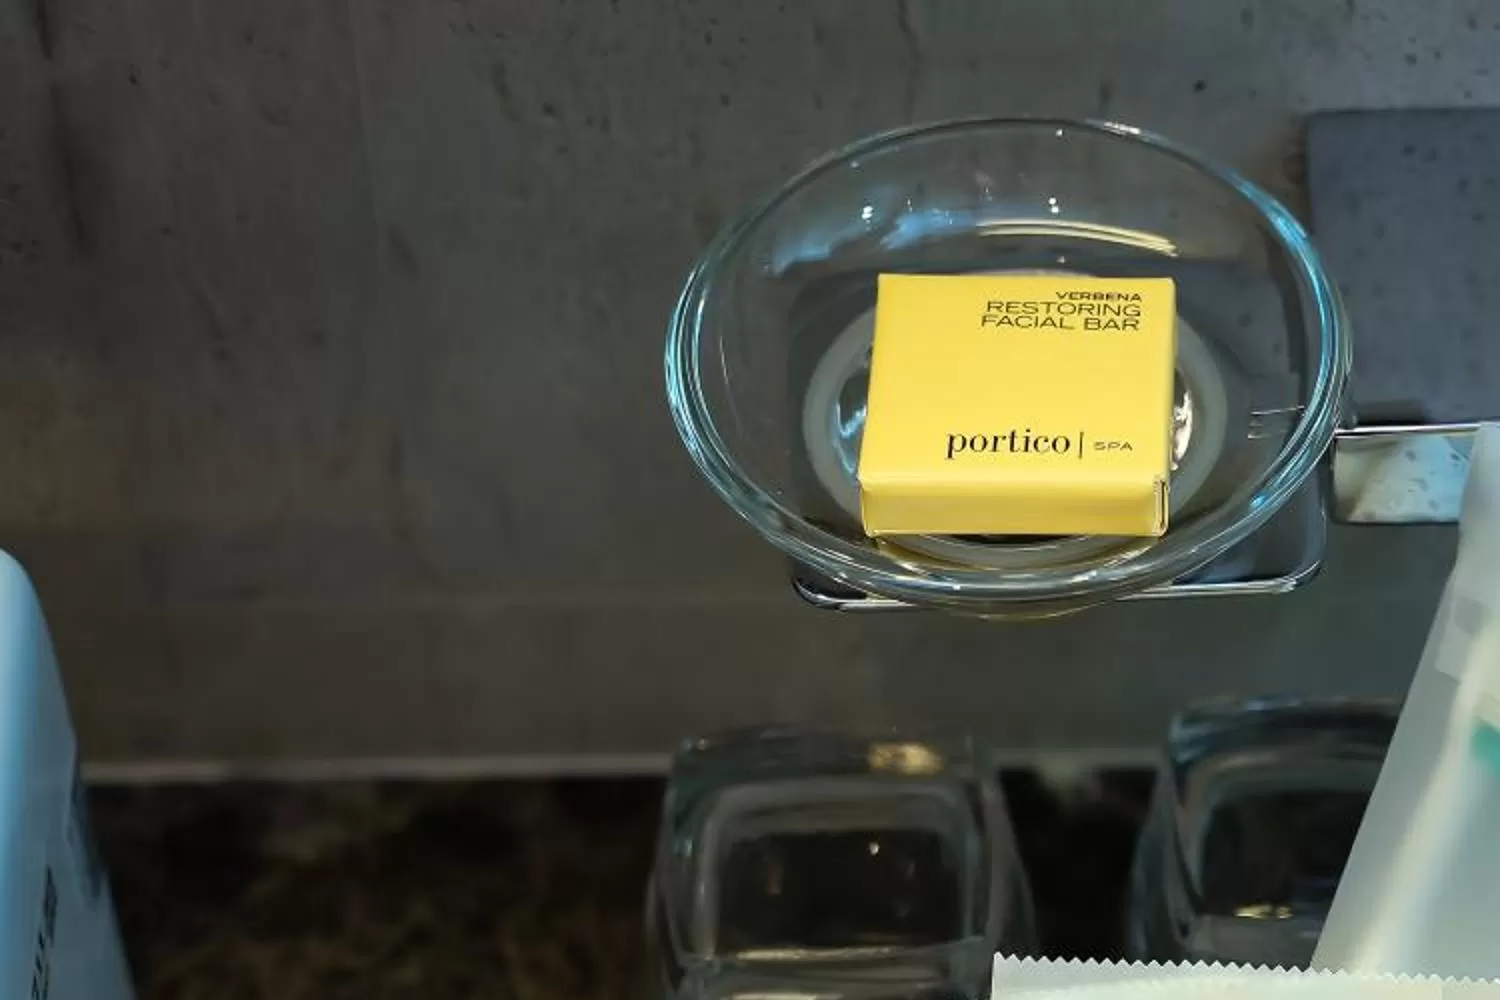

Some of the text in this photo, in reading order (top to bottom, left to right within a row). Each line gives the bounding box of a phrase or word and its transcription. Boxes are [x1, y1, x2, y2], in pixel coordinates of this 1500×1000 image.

[1056, 291, 1142, 302] VERBENA
[986, 301, 1142, 317] RESTORING
[980, 314, 1140, 332] FACIAL BAR
[945, 428, 1134, 460] portico SPA
